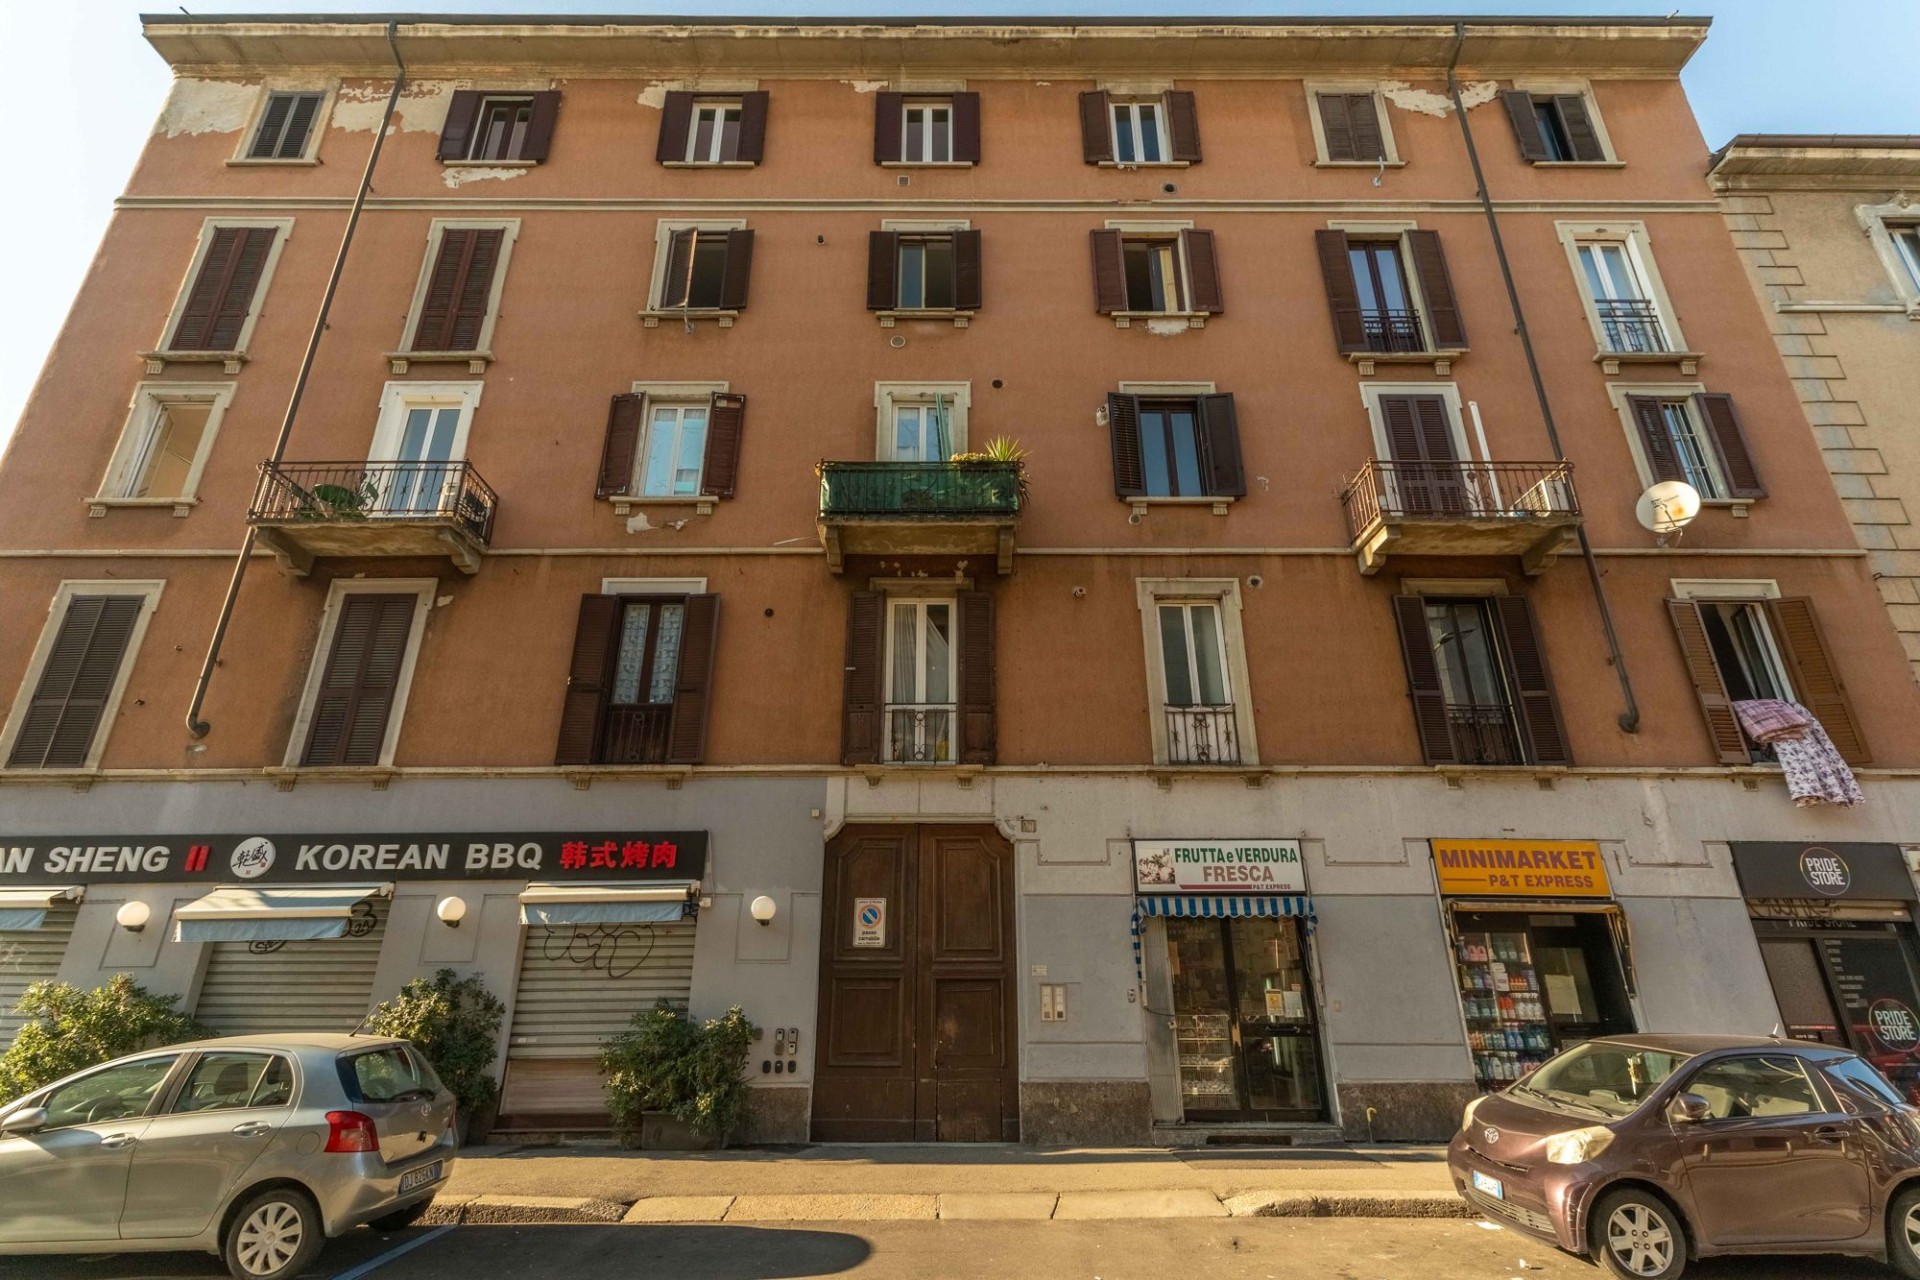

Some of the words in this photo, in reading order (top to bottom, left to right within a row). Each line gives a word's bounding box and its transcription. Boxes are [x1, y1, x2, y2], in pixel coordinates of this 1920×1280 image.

[44, 845, 171, 873] SHENG
[295, 844, 450, 871] KOREAN
[465, 842, 543, 870] BBQ
[559, 841, 677, 870] 韩式烤肉
[1174, 848, 1226, 863] FRUTTA
[1234, 848, 1299, 863] VERDURA
[1440, 849, 1596, 870] MINIMARKET
[1805, 857, 1841, 872] PRIDE
[1202, 865, 1275, 882] FRESCA
[1488, 874, 1520, 887] P&T
[1523, 874, 1594, 888] EXPRESS
[1810, 871, 1846, 885] STORE
[1874, 1010, 1911, 1025] PRIDE
[1880, 1025, 1917, 1041] STORE
